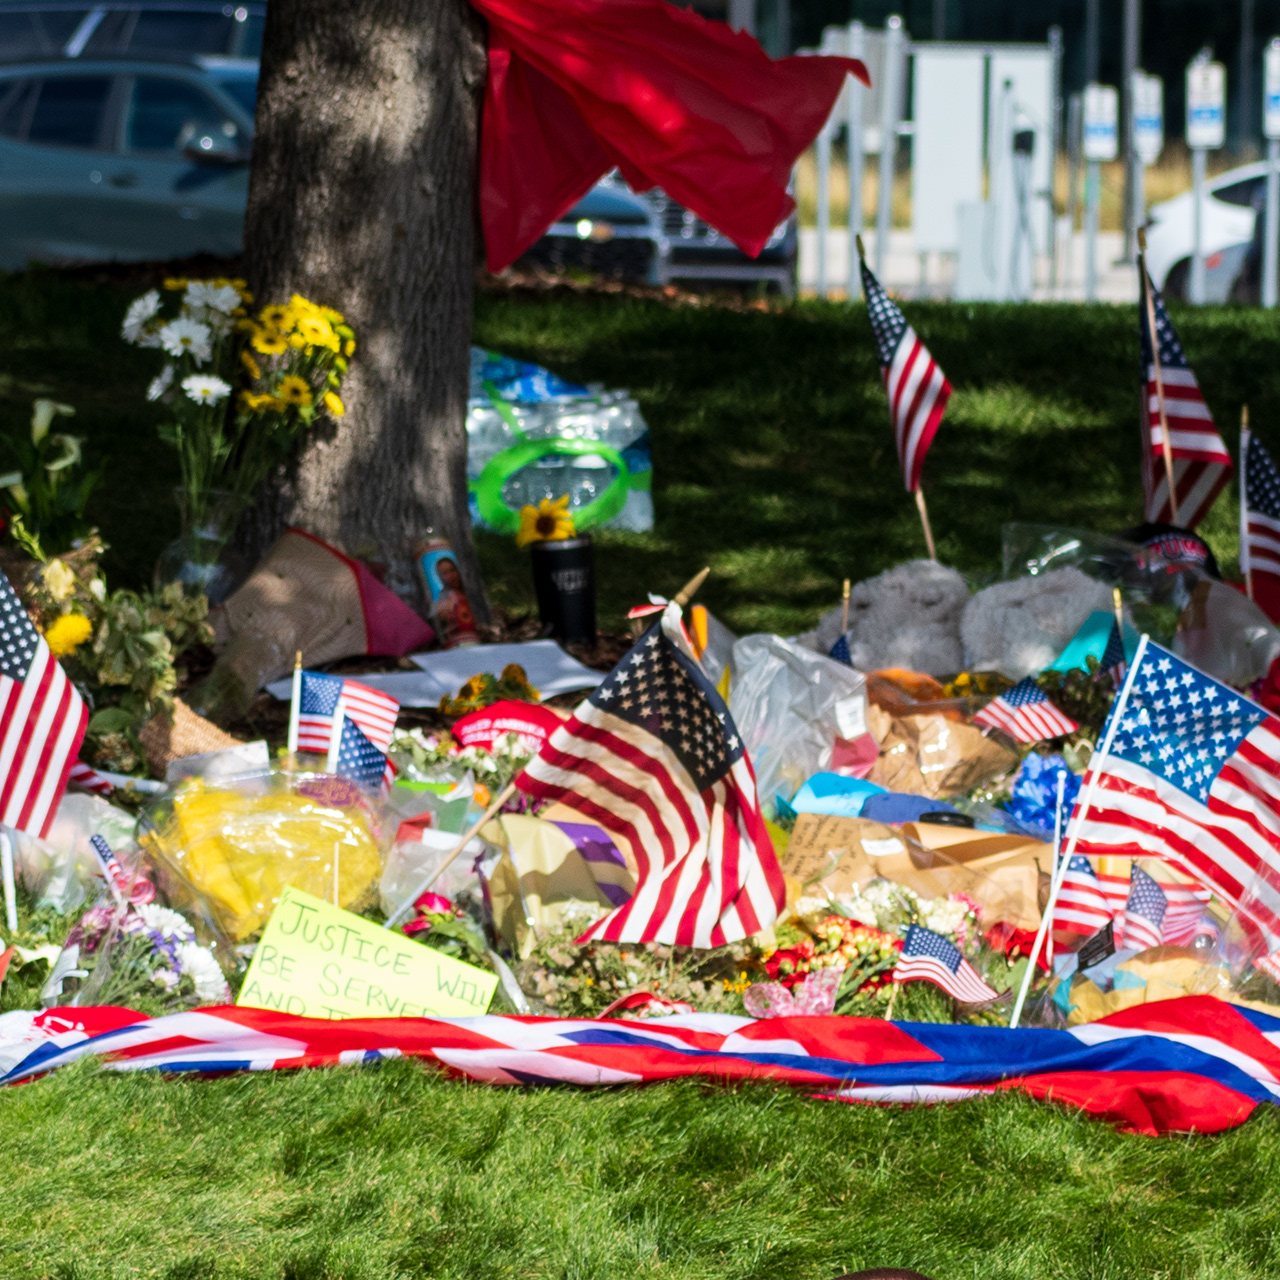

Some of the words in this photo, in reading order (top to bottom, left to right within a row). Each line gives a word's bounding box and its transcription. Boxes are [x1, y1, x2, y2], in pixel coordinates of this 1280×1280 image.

[258, 944, 296, 983] BE
[243, 979, 307, 1017] AND
[435, 964, 487, 1007] WILL
